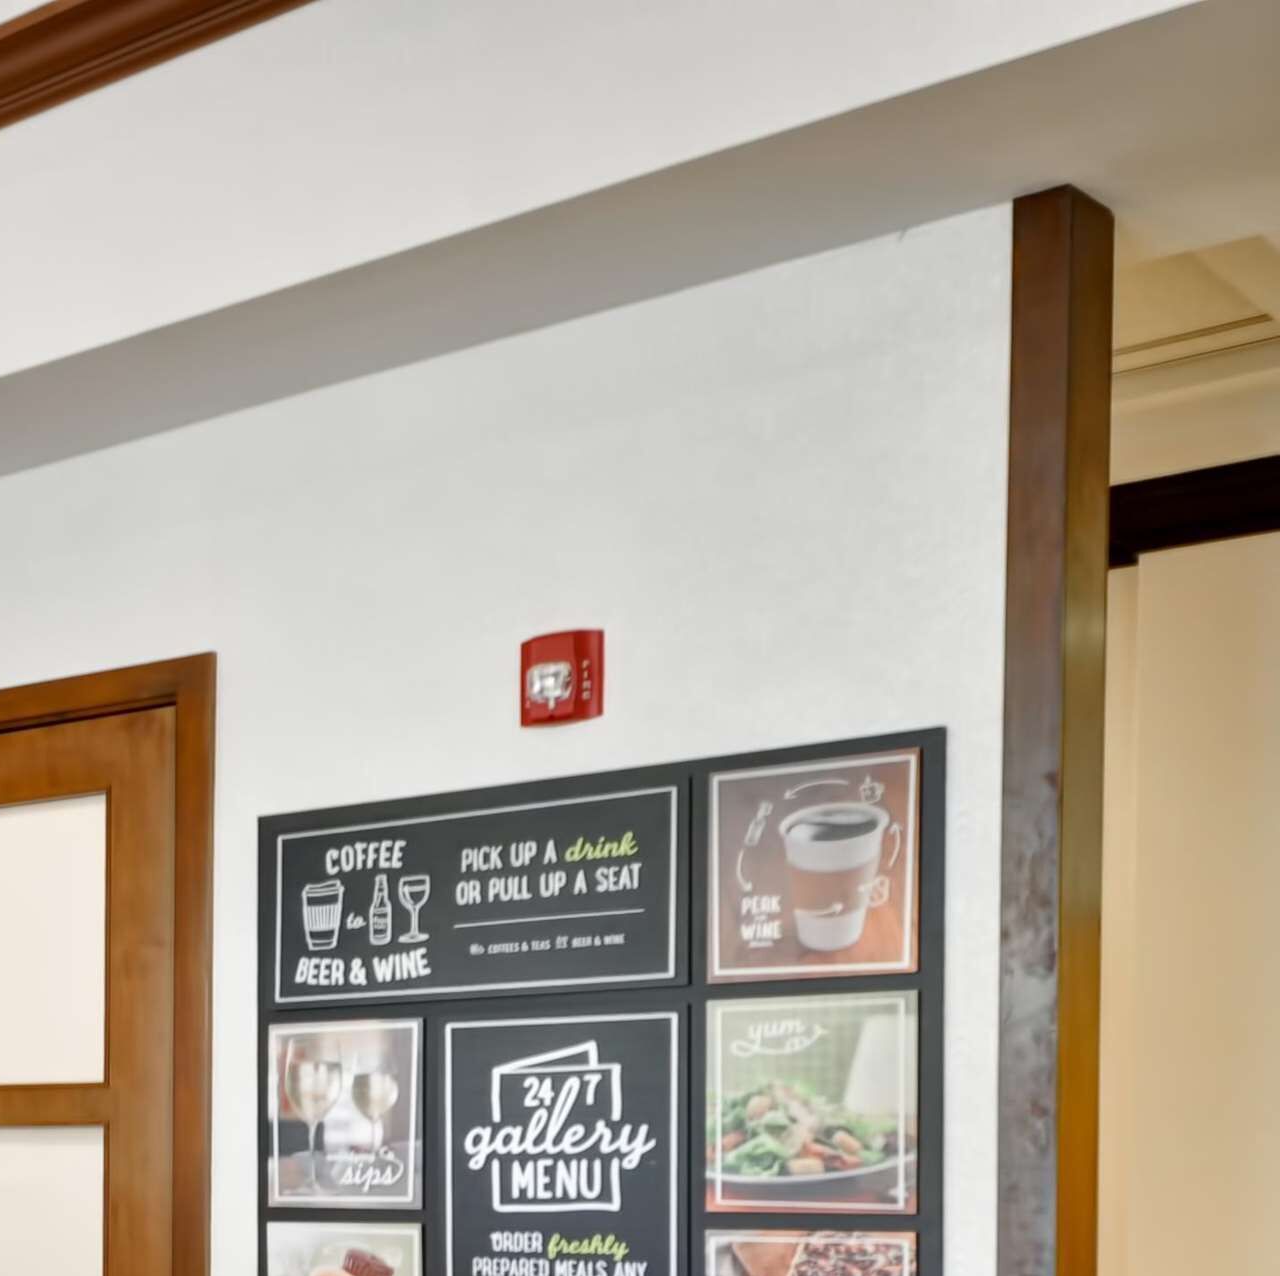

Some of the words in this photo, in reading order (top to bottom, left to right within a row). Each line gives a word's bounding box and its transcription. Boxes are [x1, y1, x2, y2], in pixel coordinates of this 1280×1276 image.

[325, 839, 407, 875] COFFEE
[460, 845, 503, 873] PICK
[509, 840, 537, 868] UP
[543, 838, 558, 865] A
[564, 830, 639, 863] drink
[455, 879, 482, 906] OR
[488, 875, 533, 903] PULL
[539, 870, 567, 898] UP
[573, 869, 588, 895] A
[595, 862, 642, 893] SEAT
[346, 912, 367, 930] to
[294, 956, 345, 986] BEER
[349, 957, 368, 986] &
[372, 947, 432, 983] WINE
[464, 1075, 656, 1170] gallery
[339, 1161, 402, 1193] sips
[512, 1158, 602, 1199] MENU
[489, 1231, 544, 1253] ORDER
[548, 1232, 629, 1261] freshly
